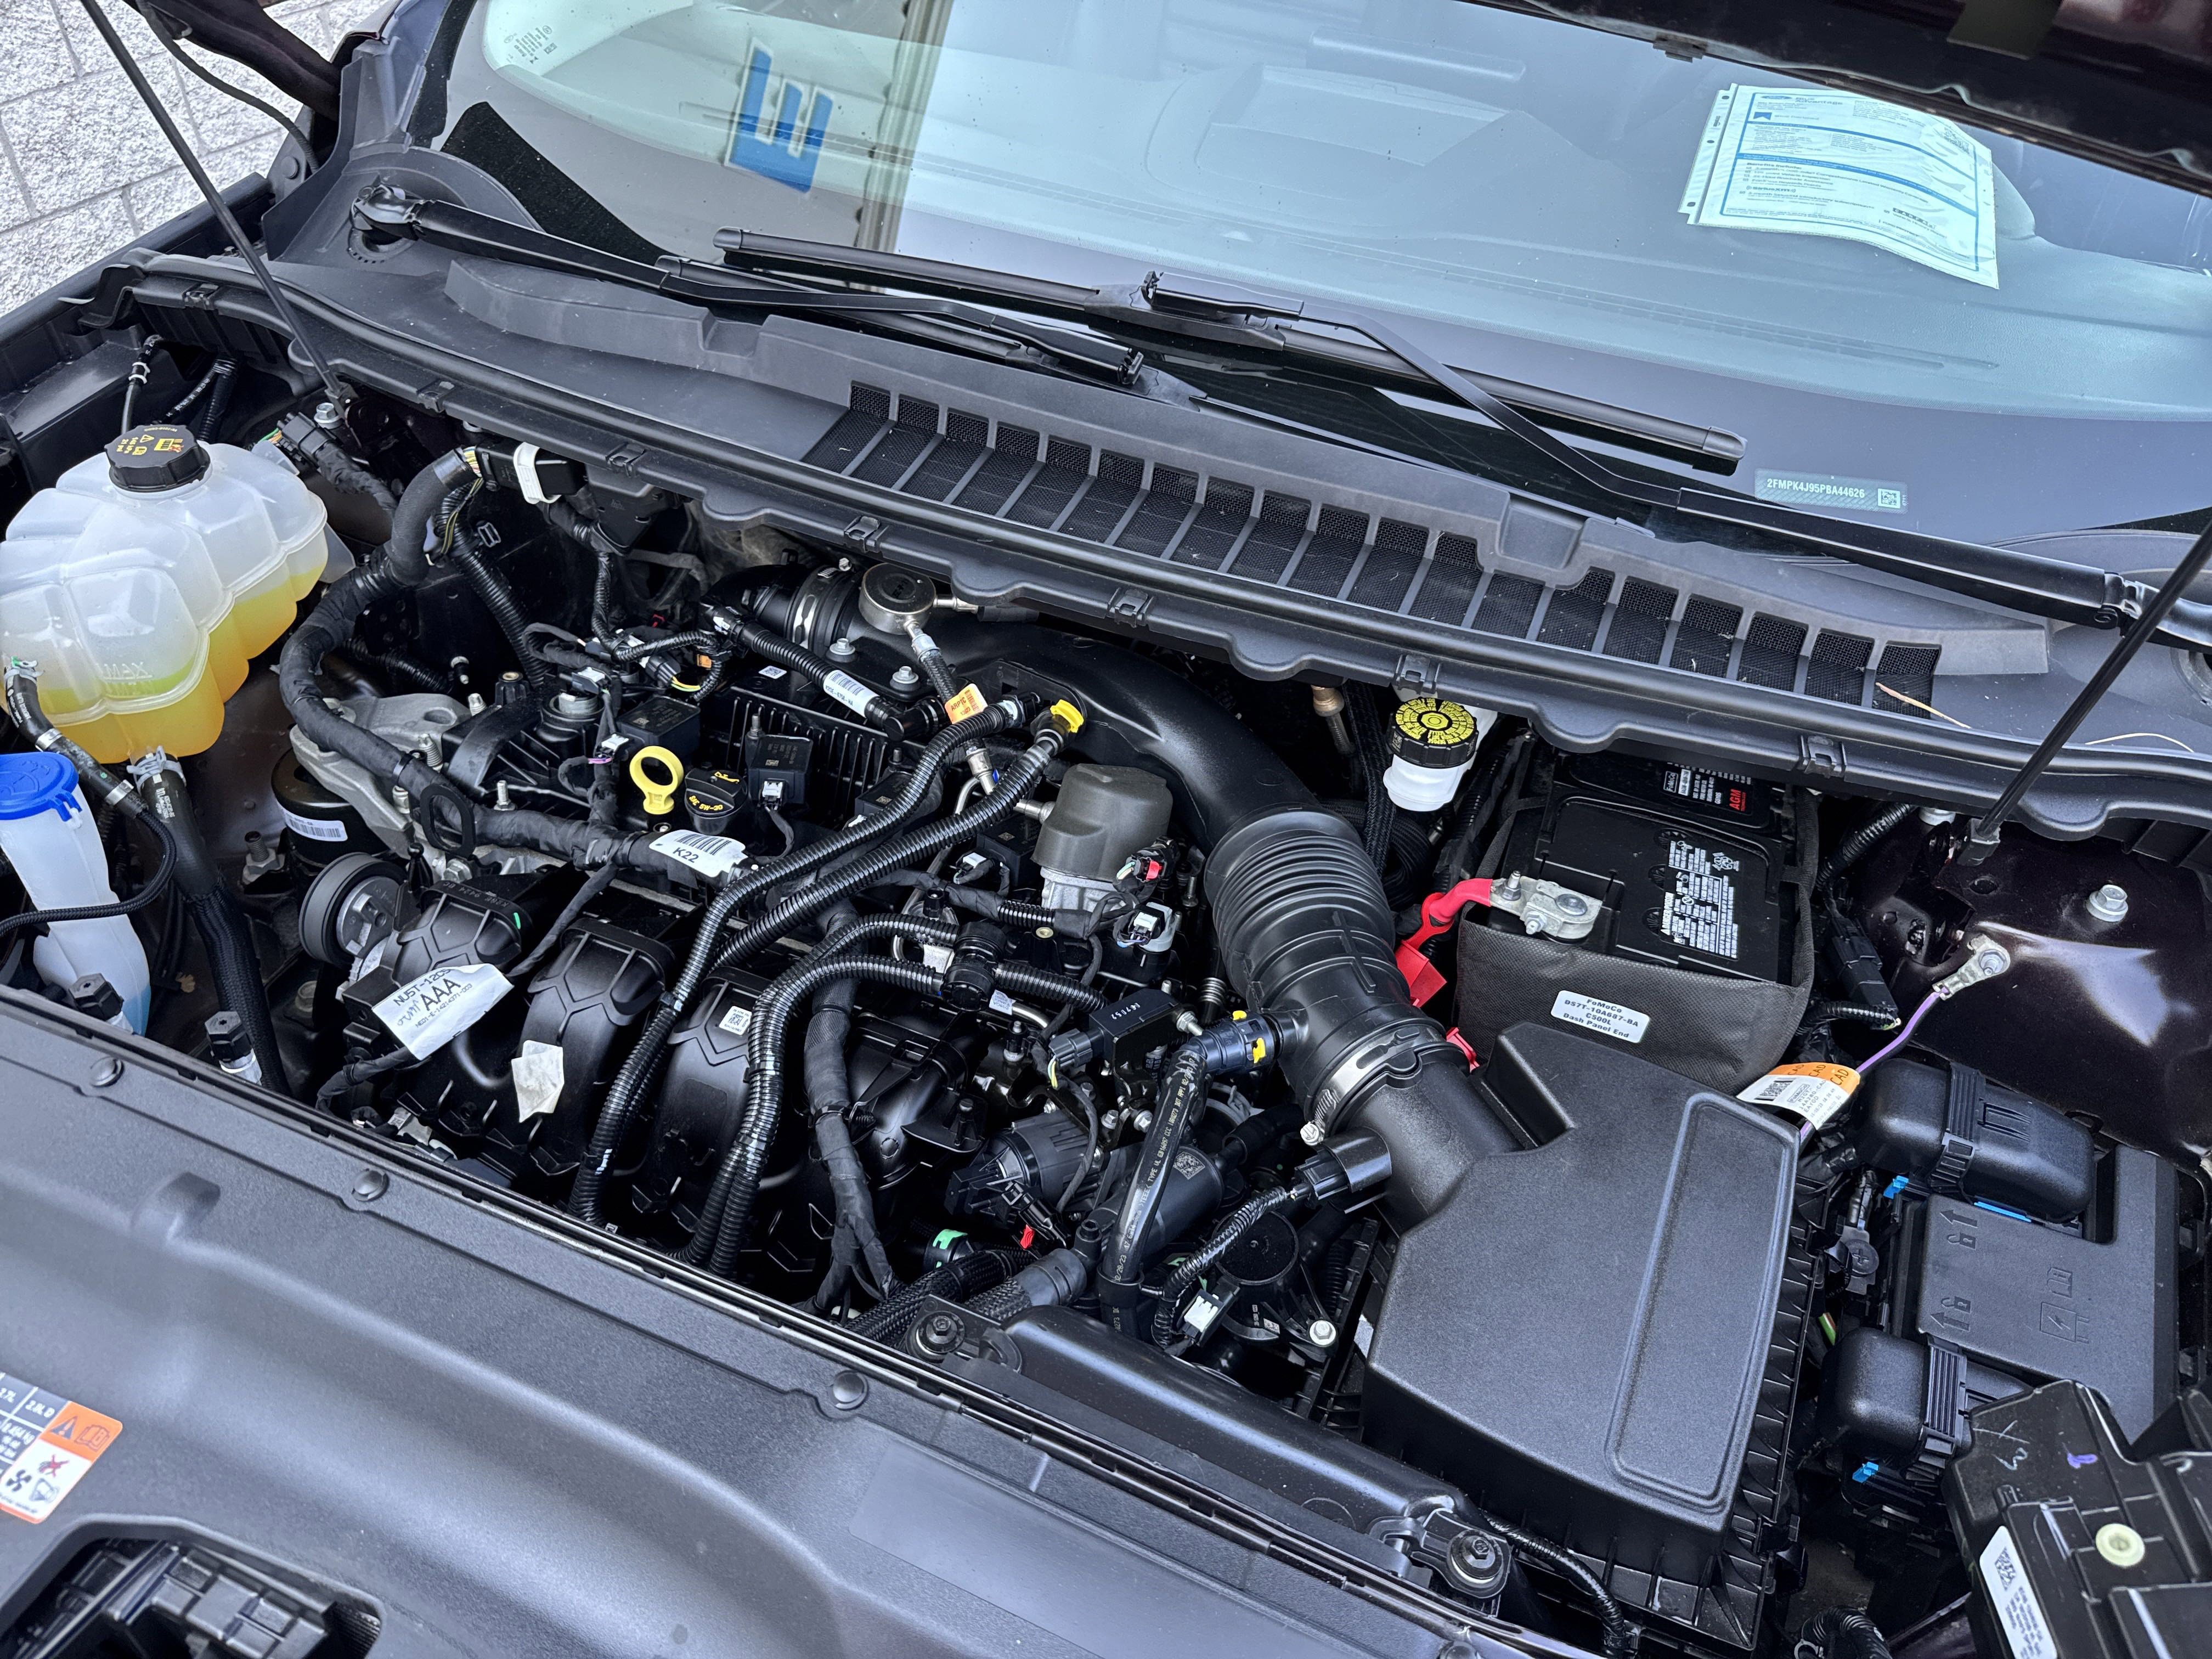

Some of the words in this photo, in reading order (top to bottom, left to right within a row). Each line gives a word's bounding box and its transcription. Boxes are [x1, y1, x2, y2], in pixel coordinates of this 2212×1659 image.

[1766, 478, 1866, 499] 2FMPK4J95PBA44626
[689, 795, 700, 806] SAE
[1729, 788, 1742, 811] AGM
[672, 847, 699, 864] K22
[420, 978, 462, 1012] AAA
[1564, 1000, 1639, 1027] DS7T-10A687-BA
[1586, 998, 1622, 1014] FoMoCo
[1563, 1013, 1584, 1024] Dash
[1586, 1020, 1611, 1032] Panel
[1612, 1029, 1630, 1039] End
[1585, 1013, 1612, 1025] C500L
[1808, 1064, 1826, 1077] CAD
[1830, 1068, 1849, 1086] CAD
[1147, 1167, 1158, 1182] TYPE
